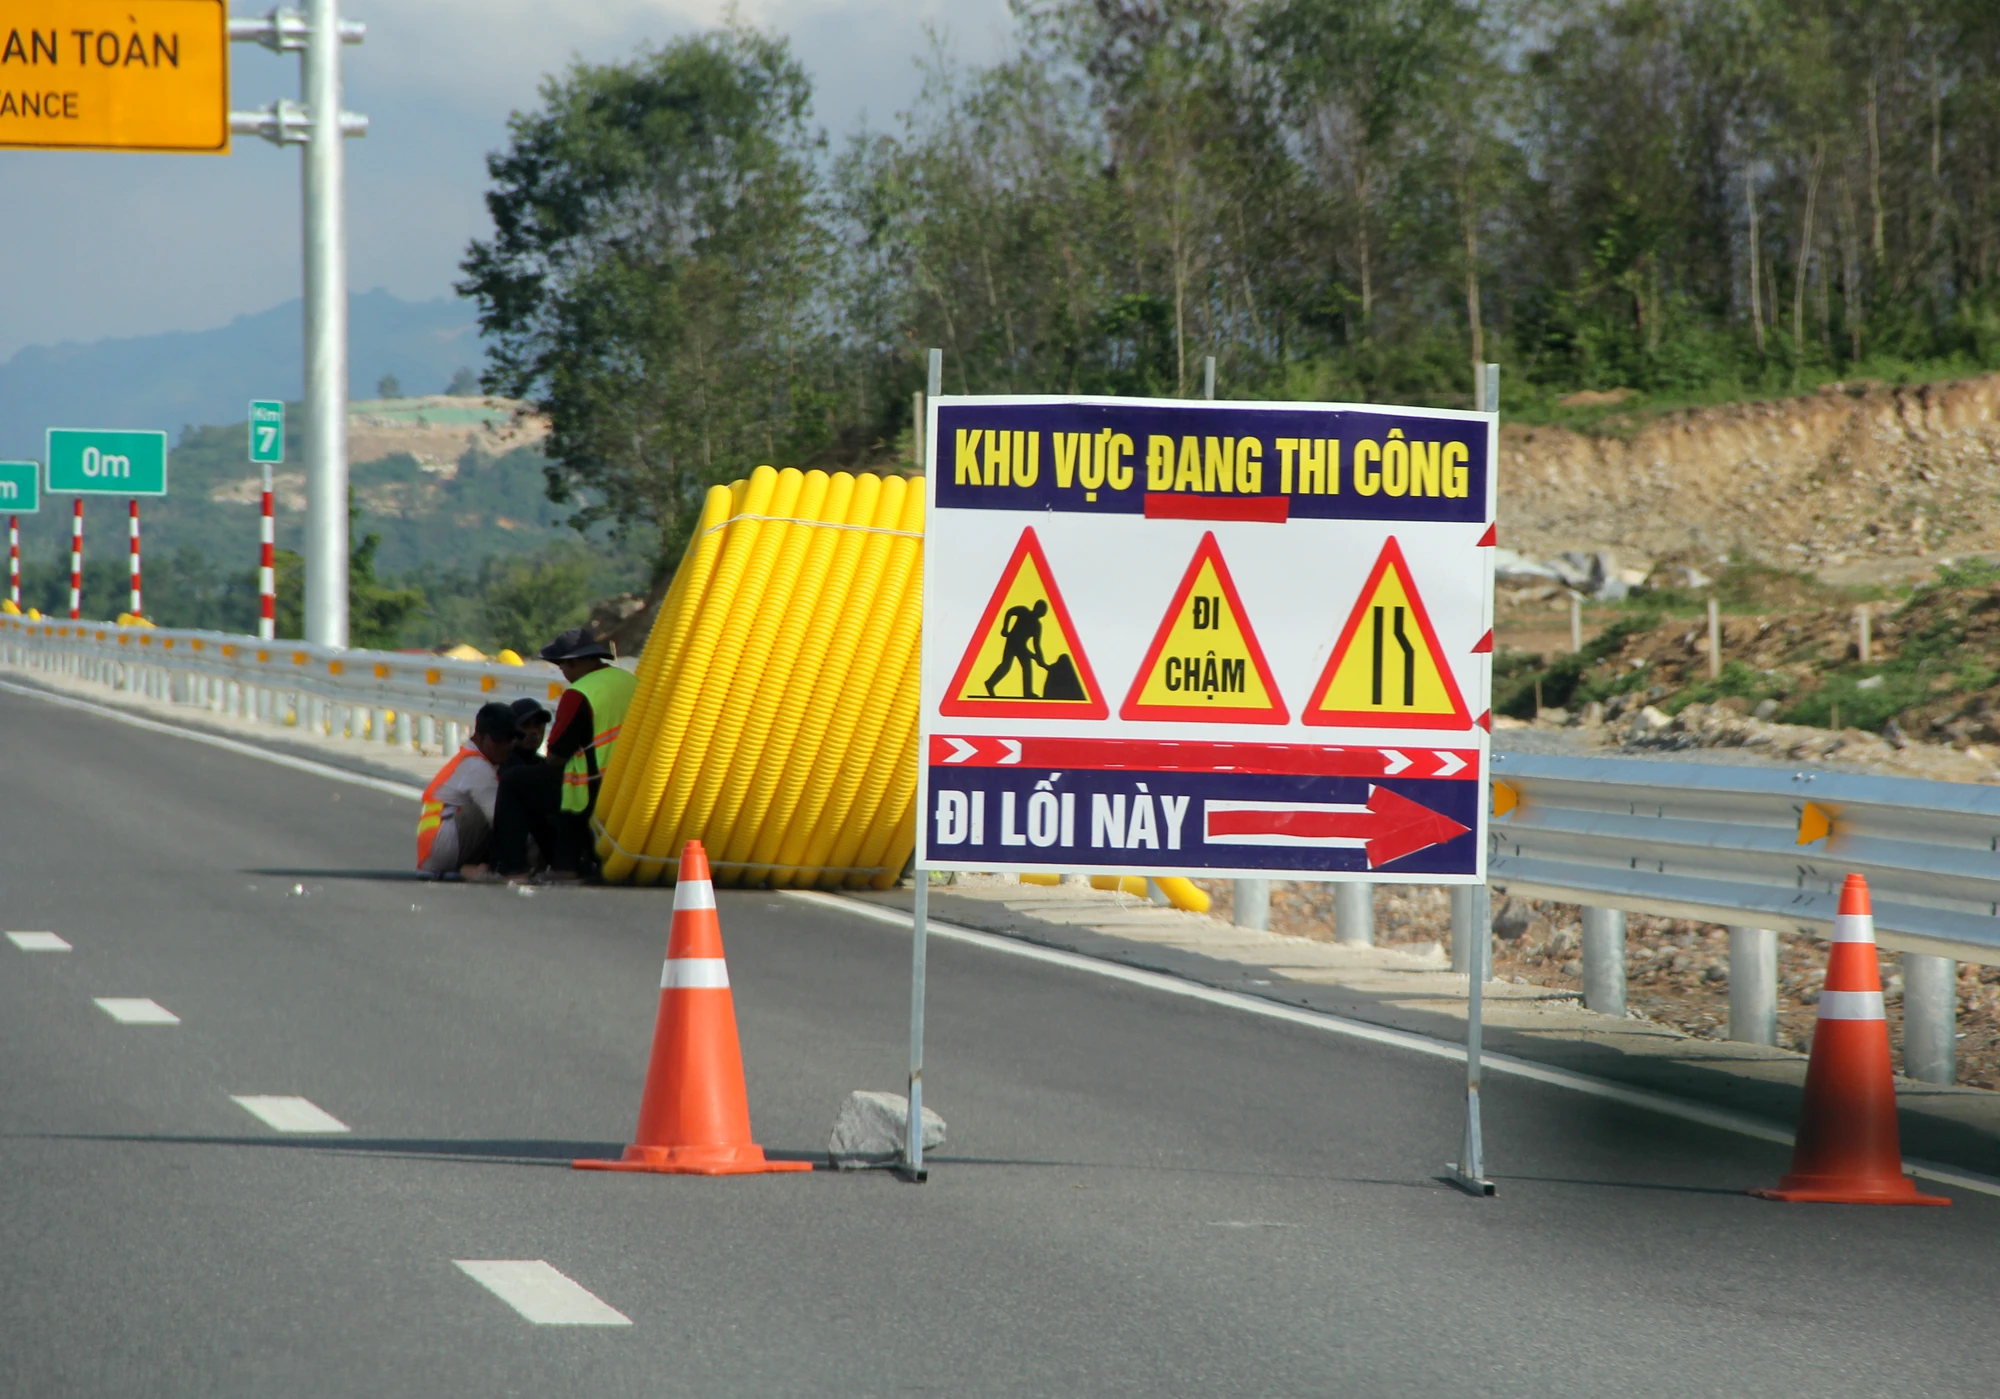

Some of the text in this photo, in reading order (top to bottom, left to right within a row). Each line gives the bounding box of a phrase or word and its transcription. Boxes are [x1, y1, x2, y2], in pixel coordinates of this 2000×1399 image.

[1, 14, 179, 68] AN TOÀN
[0, 90, 80, 119] ANCE
[253, 406, 281, 421] Km
[257, 426, 277, 453] 7
[82, 446, 130, 478] 0m
[955, 427, 1469, 502] KHU VỰC ĐANG THI CÔNG
[1192, 595, 1220, 630] ĐI
[1165, 650, 1246, 700] CHẬM
[935, 772, 1191, 850] ĐI LỐI NÀY
